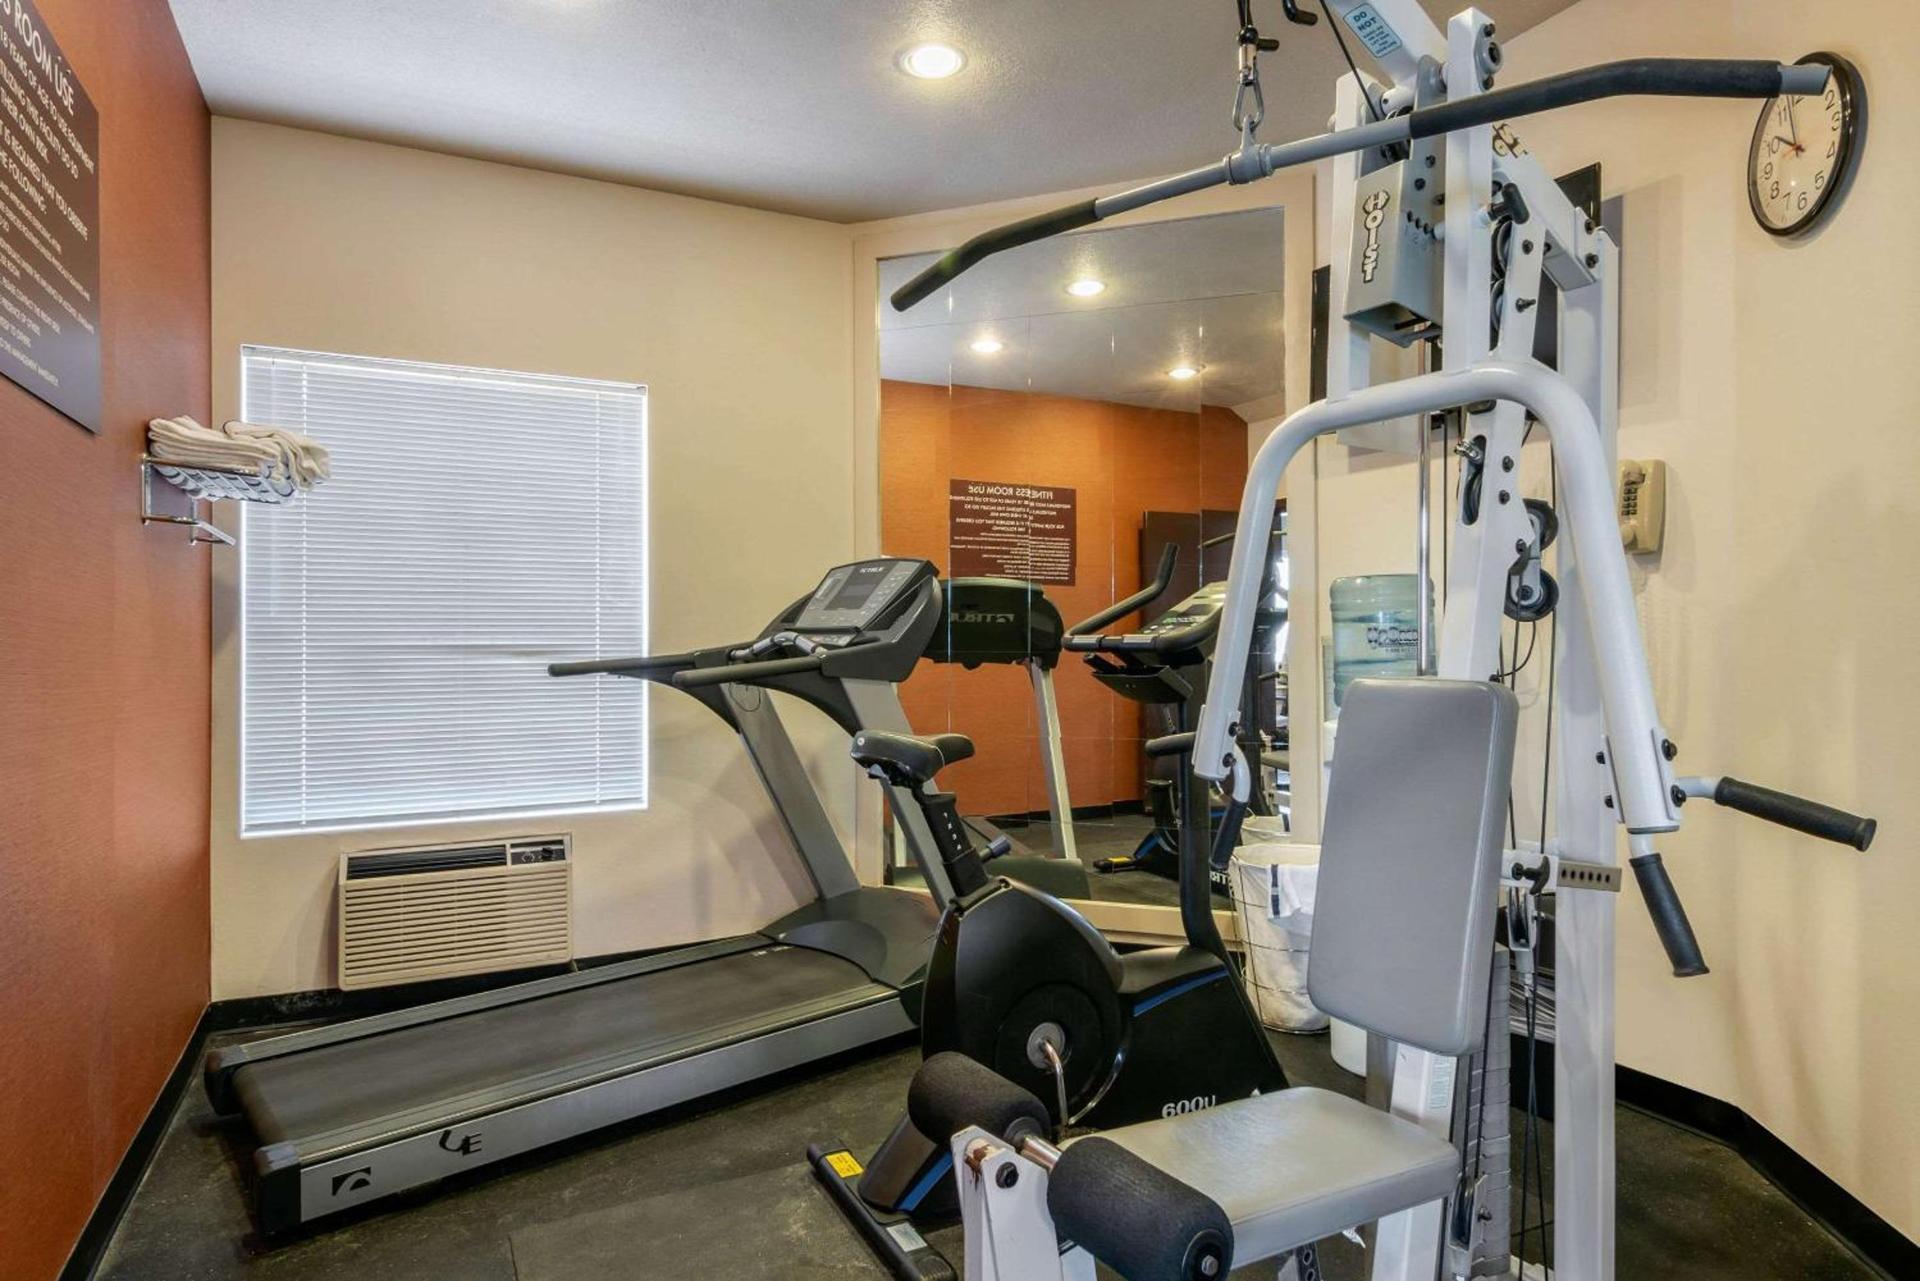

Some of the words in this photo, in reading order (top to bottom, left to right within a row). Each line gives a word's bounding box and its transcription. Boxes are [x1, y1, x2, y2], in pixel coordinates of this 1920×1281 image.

[1353, 11, 1367, 22] DO
[14, 0, 51, 82] ROOM
[54, 63, 73, 116] USE
[1826, 141, 1835, 159] 4
[1764, 162, 1773, 180] 9
[1815, 170, 1825, 190] 5
[1770, 181, 1780, 200] 8
[1797, 192, 1808, 210] 6
